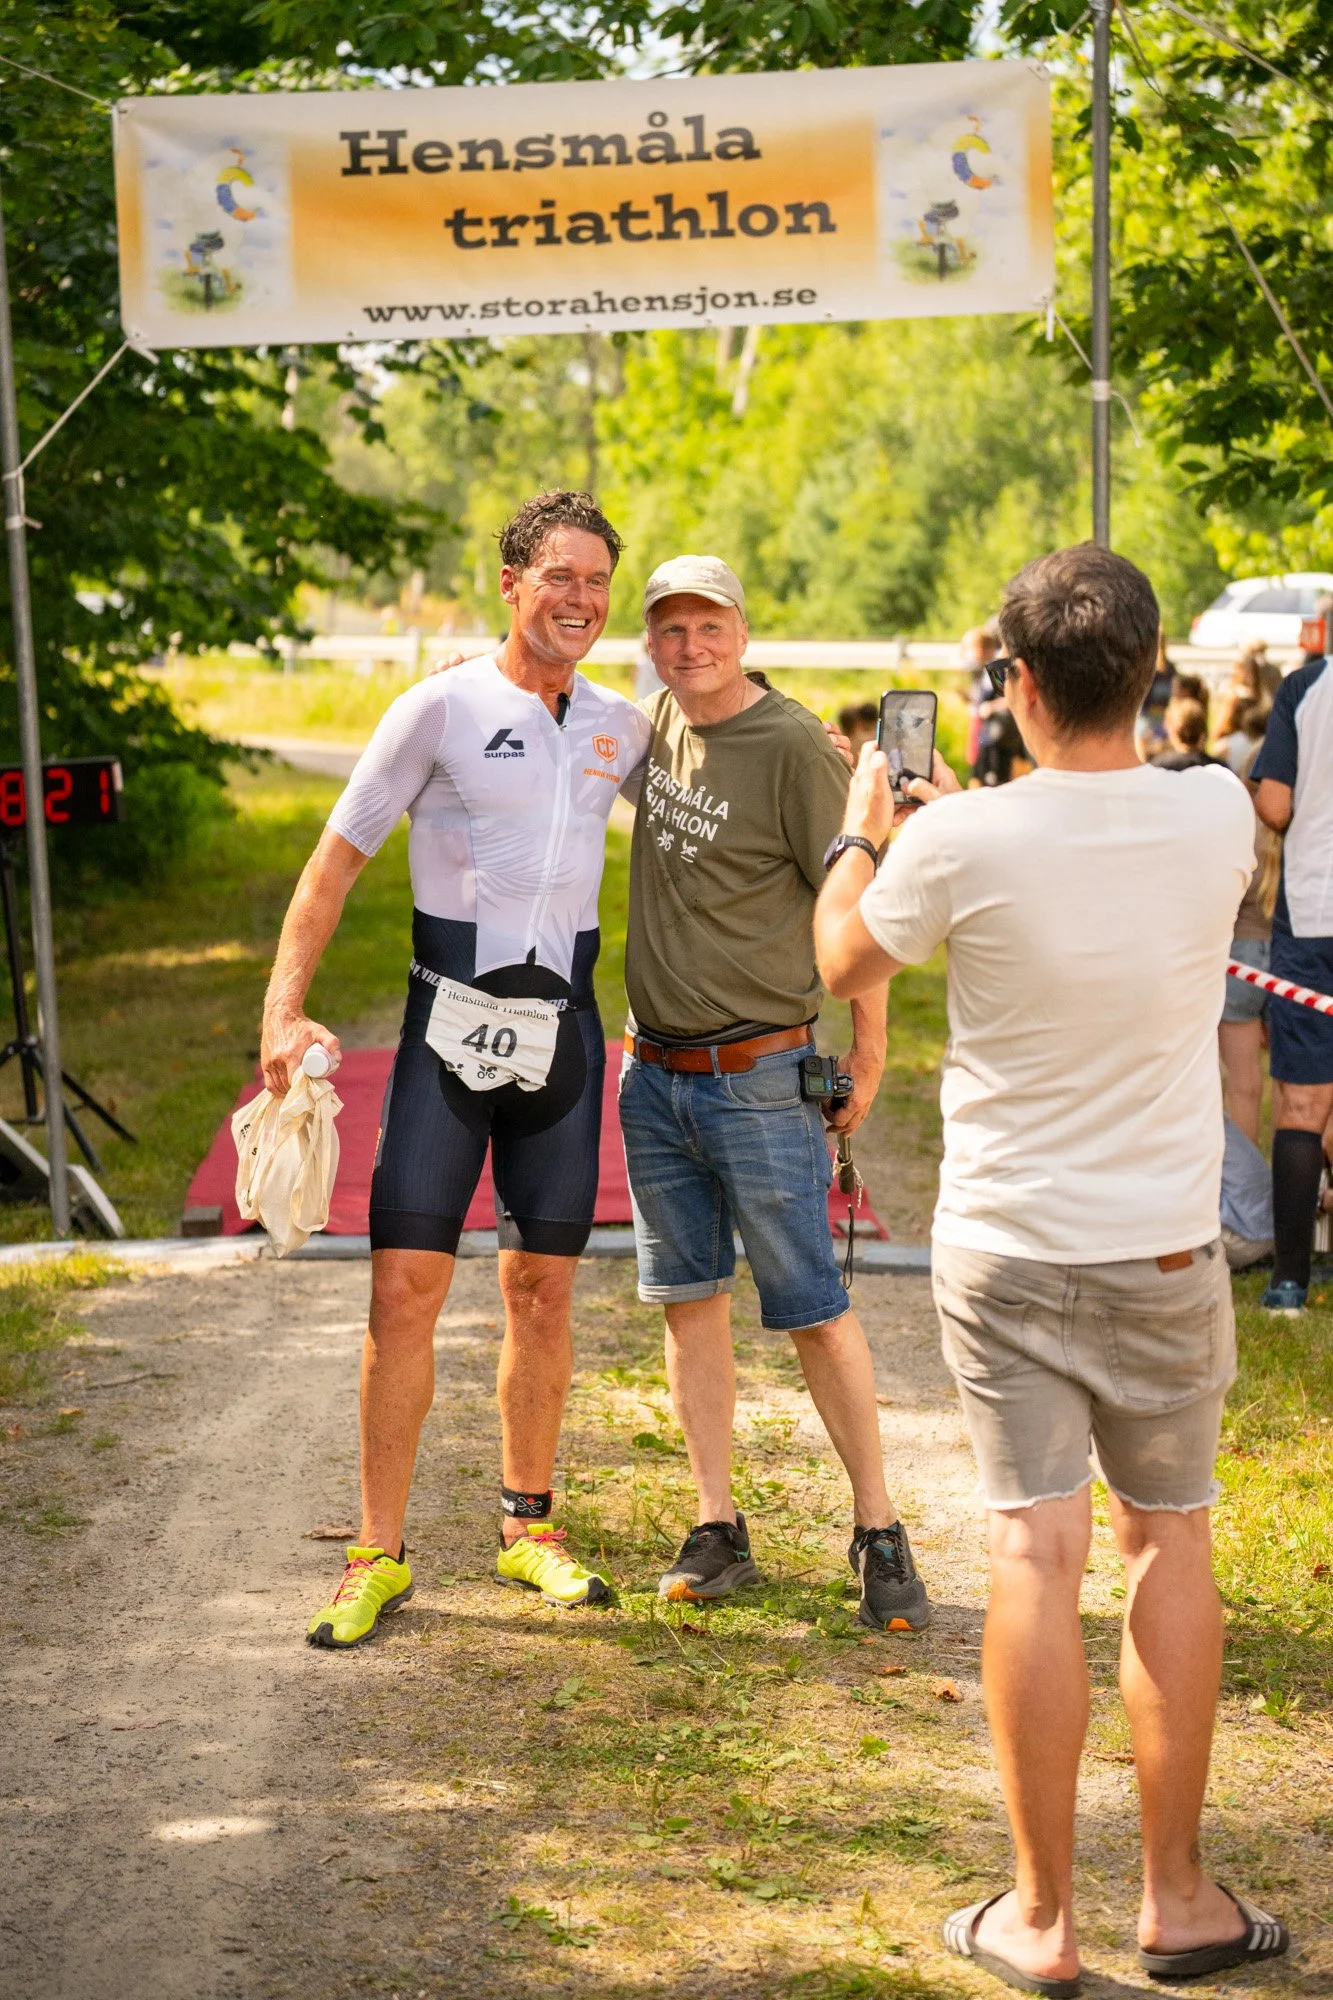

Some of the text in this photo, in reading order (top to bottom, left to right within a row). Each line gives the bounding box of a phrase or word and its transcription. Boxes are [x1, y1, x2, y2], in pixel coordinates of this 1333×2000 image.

[340, 111, 762, 176] Hensmåla
[444, 190, 837, 249] triathlon
[363, 286, 818, 323] www.storahensjon.se
[483, 751, 526, 759] surpas
[648, 757, 729, 820] HENSMÅLA
[461, 1023, 518, 1058] 40
